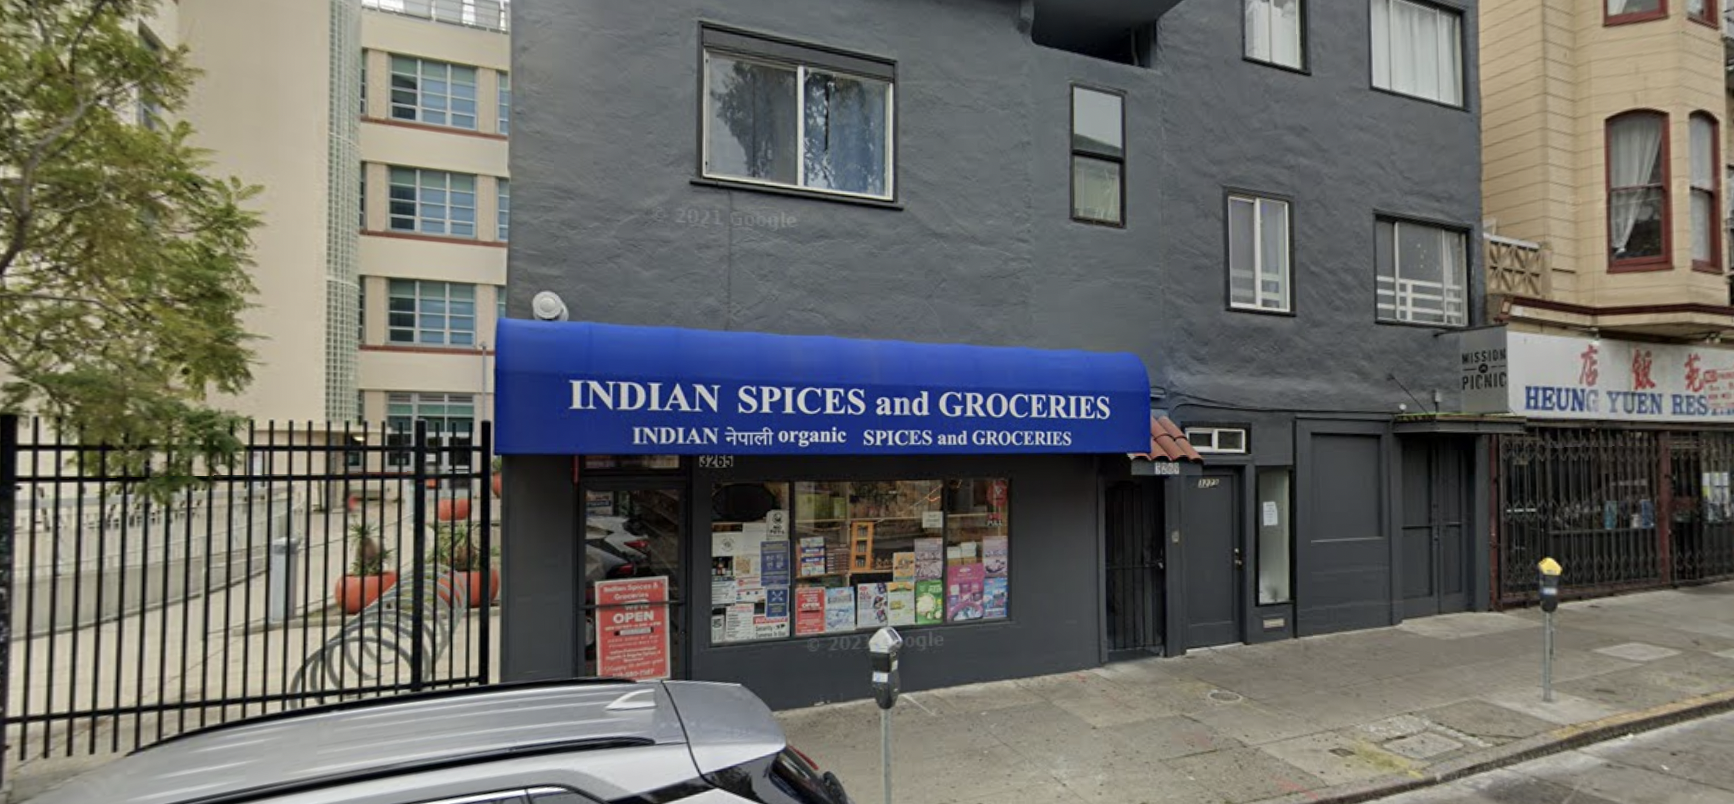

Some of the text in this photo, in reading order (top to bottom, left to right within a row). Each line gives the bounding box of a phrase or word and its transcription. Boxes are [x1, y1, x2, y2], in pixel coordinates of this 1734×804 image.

[1461, 348, 1507, 365] MISSION
[1462, 372, 1507, 390] PICNIC
[569, 380, 1111, 419] INDIAN SPICES and GROCERIES
[1525, 385, 1598, 412] HEUNG
[1606, 390, 1664, 415] YUEN
[632, 427, 1072, 447] INDIAN नेपाली organic SPICES and GROCERIES
[699, 455, 733, 468] 3265
[613, 610, 655, 624] OPEN
